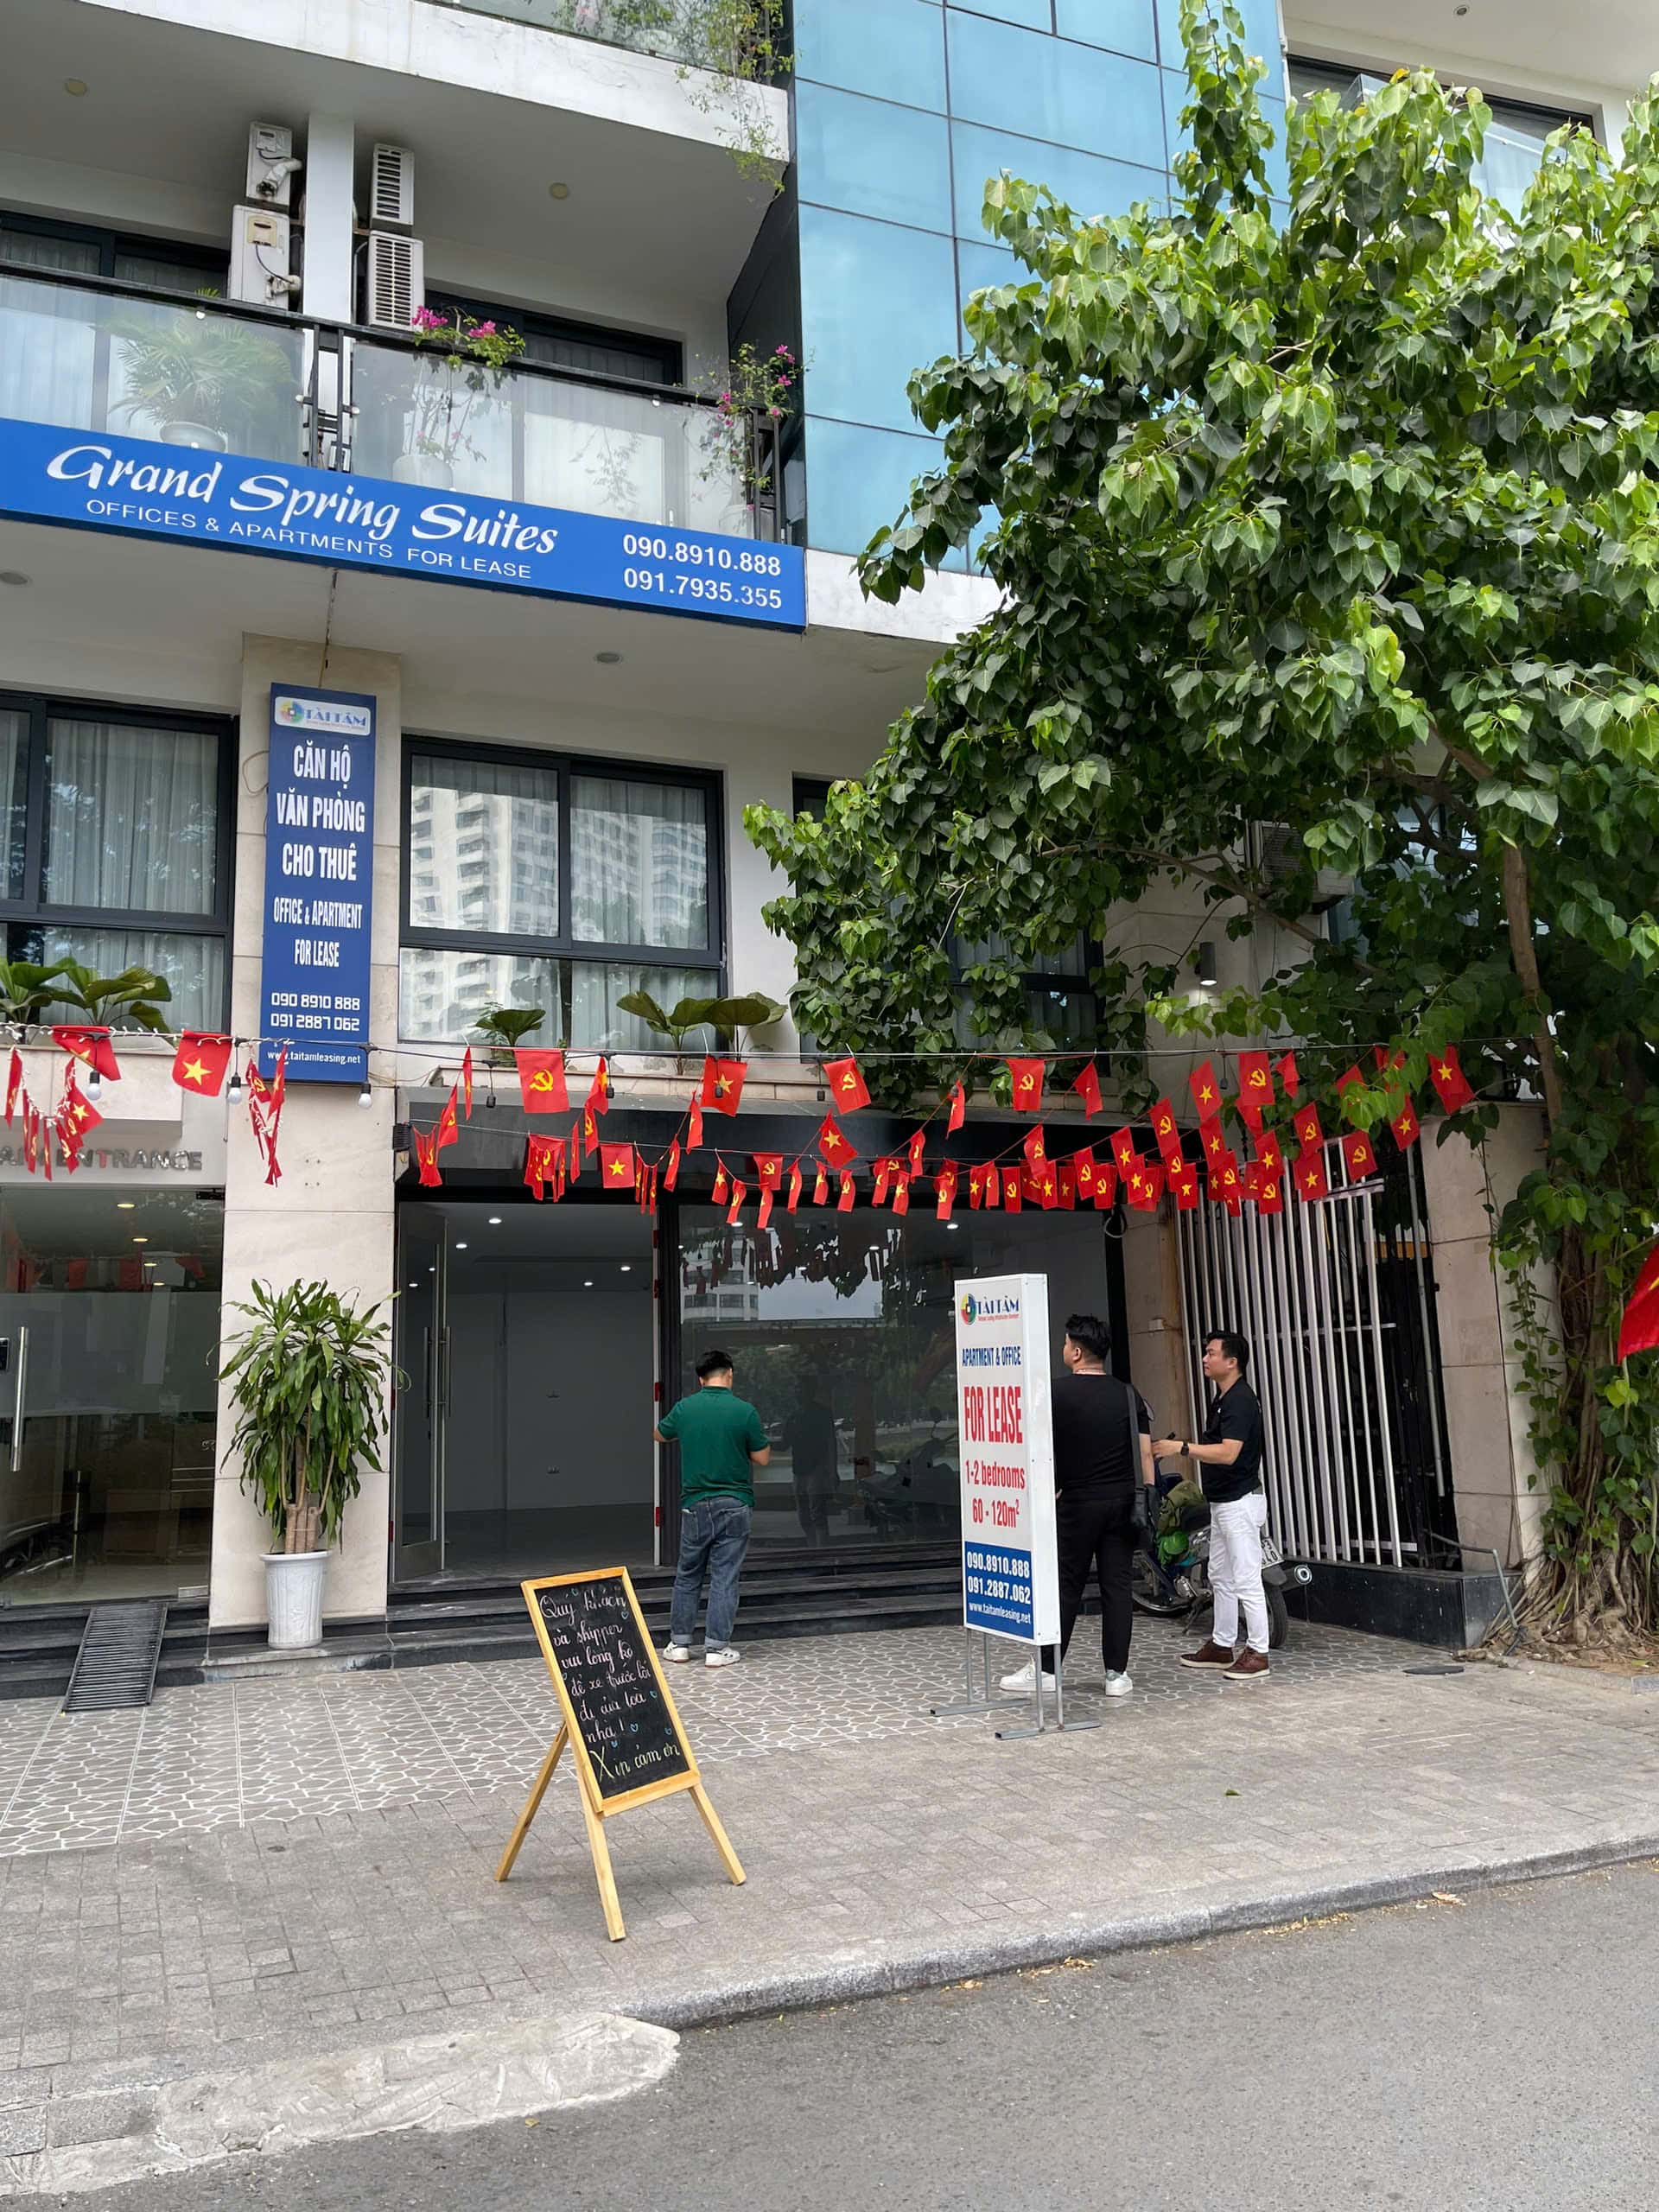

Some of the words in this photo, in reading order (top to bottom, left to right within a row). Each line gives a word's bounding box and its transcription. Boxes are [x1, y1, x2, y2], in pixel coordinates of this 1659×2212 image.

[47, 445, 223, 504] Grand
[229, 474, 401, 541] Spring
[411, 504, 559, 554] Suites
[86, 499, 196, 529] OFFICES
[205, 518, 219, 532] &
[229, 522, 393, 558] APARTMENTS
[407, 548, 453, 568] FOR
[461, 556, 531, 579] LEASE
[623, 534, 781, 576] 090.8910.888
[624, 568, 782, 609] 091.7935.355
[294, 740, 326, 780] CĂN
[330, 745, 351, 789] HỘ
[276, 787, 308, 827] VĂN
[312, 791, 365, 833] PHÒNG
[282, 842, 314, 878] CHO
[319, 842, 357, 881] THUÊ
[274, 897, 303, 925] OFFICE
[304, 906, 310, 925] &
[311, 900, 363, 929] APARTMENT
[295, 939, 311, 965] FOR
[313, 940, 340, 968] LEASE
[271, 992, 298, 1007] 090
[301, 994, 332, 1009] 8910
[334, 996, 360, 1011] 888
[270, 1013, 293, 1027] 091
[296, 1014, 331, 1030] 2887
[334, 1016, 360, 1032] 062
[962, 1348, 994, 1366] APARTMENT
[995, 1348, 1000, 1365] &
[1001, 1346, 1021, 1365] OFFICE
[963, 1386, 985, 1441] FOR
[987, 1385, 1023, 1444] LEASE
[965, 1459, 979, 1484] 1-2
[982, 1460, 1025, 1490] bedrooms
[973, 1497, 982, 1523] 60
[967, 1551, 1030, 1579] 090.8910.888
[968, 1575, 1032, 1605] 091.2887.062
[539, 1593, 576, 1626] Quý
[553, 1628, 571, 1647] và
[576, 1620, 623, 1646] shipper
[586, 1646, 615, 1674] lòng
[589, 1679, 603, 1690] xe
